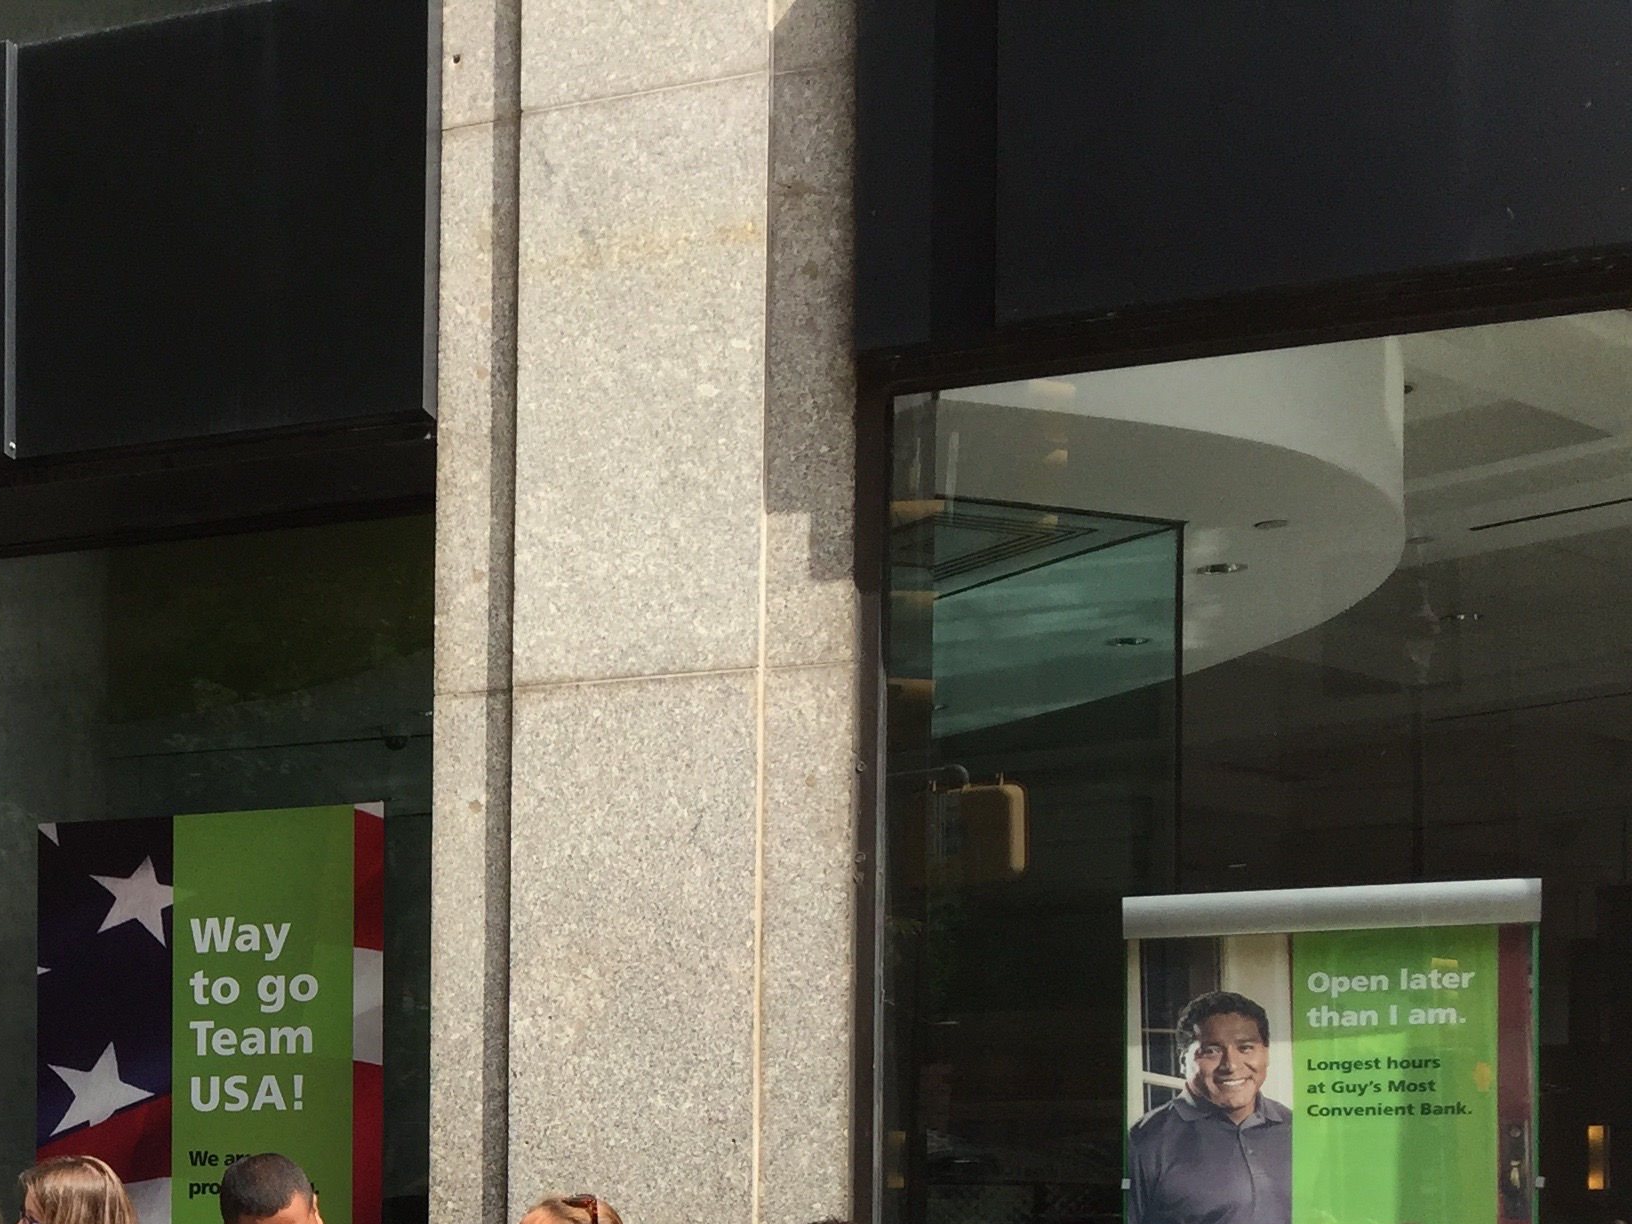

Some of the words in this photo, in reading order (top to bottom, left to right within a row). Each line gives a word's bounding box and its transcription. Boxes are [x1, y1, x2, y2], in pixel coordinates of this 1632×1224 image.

[189, 916, 292, 961] Way
[189, 969, 241, 1005] to
[257, 973, 319, 1013] go
[1307, 971, 1389, 998] Open
[1400, 968, 1475, 991] later
[1306, 1005, 1379, 1028] than
[1389, 1004, 1398, 1026] I
[1408, 1007, 1467, 1025] am.
[189, 1020, 313, 1056] Team
[1307, 1057, 1382, 1074] Longest
[1386, 1056, 1442, 1070] hours
[190, 1074, 304, 1112] USA!
[1307, 1082, 1327, 1094] at
[1331, 1080, 1383, 1097] Guy's
[1388, 1080, 1437, 1093] Most
[1307, 1102, 1416, 1118] Convenient
[1420, 1101, 1473, 1116] Bank.
[188, 1150, 220, 1167] We
